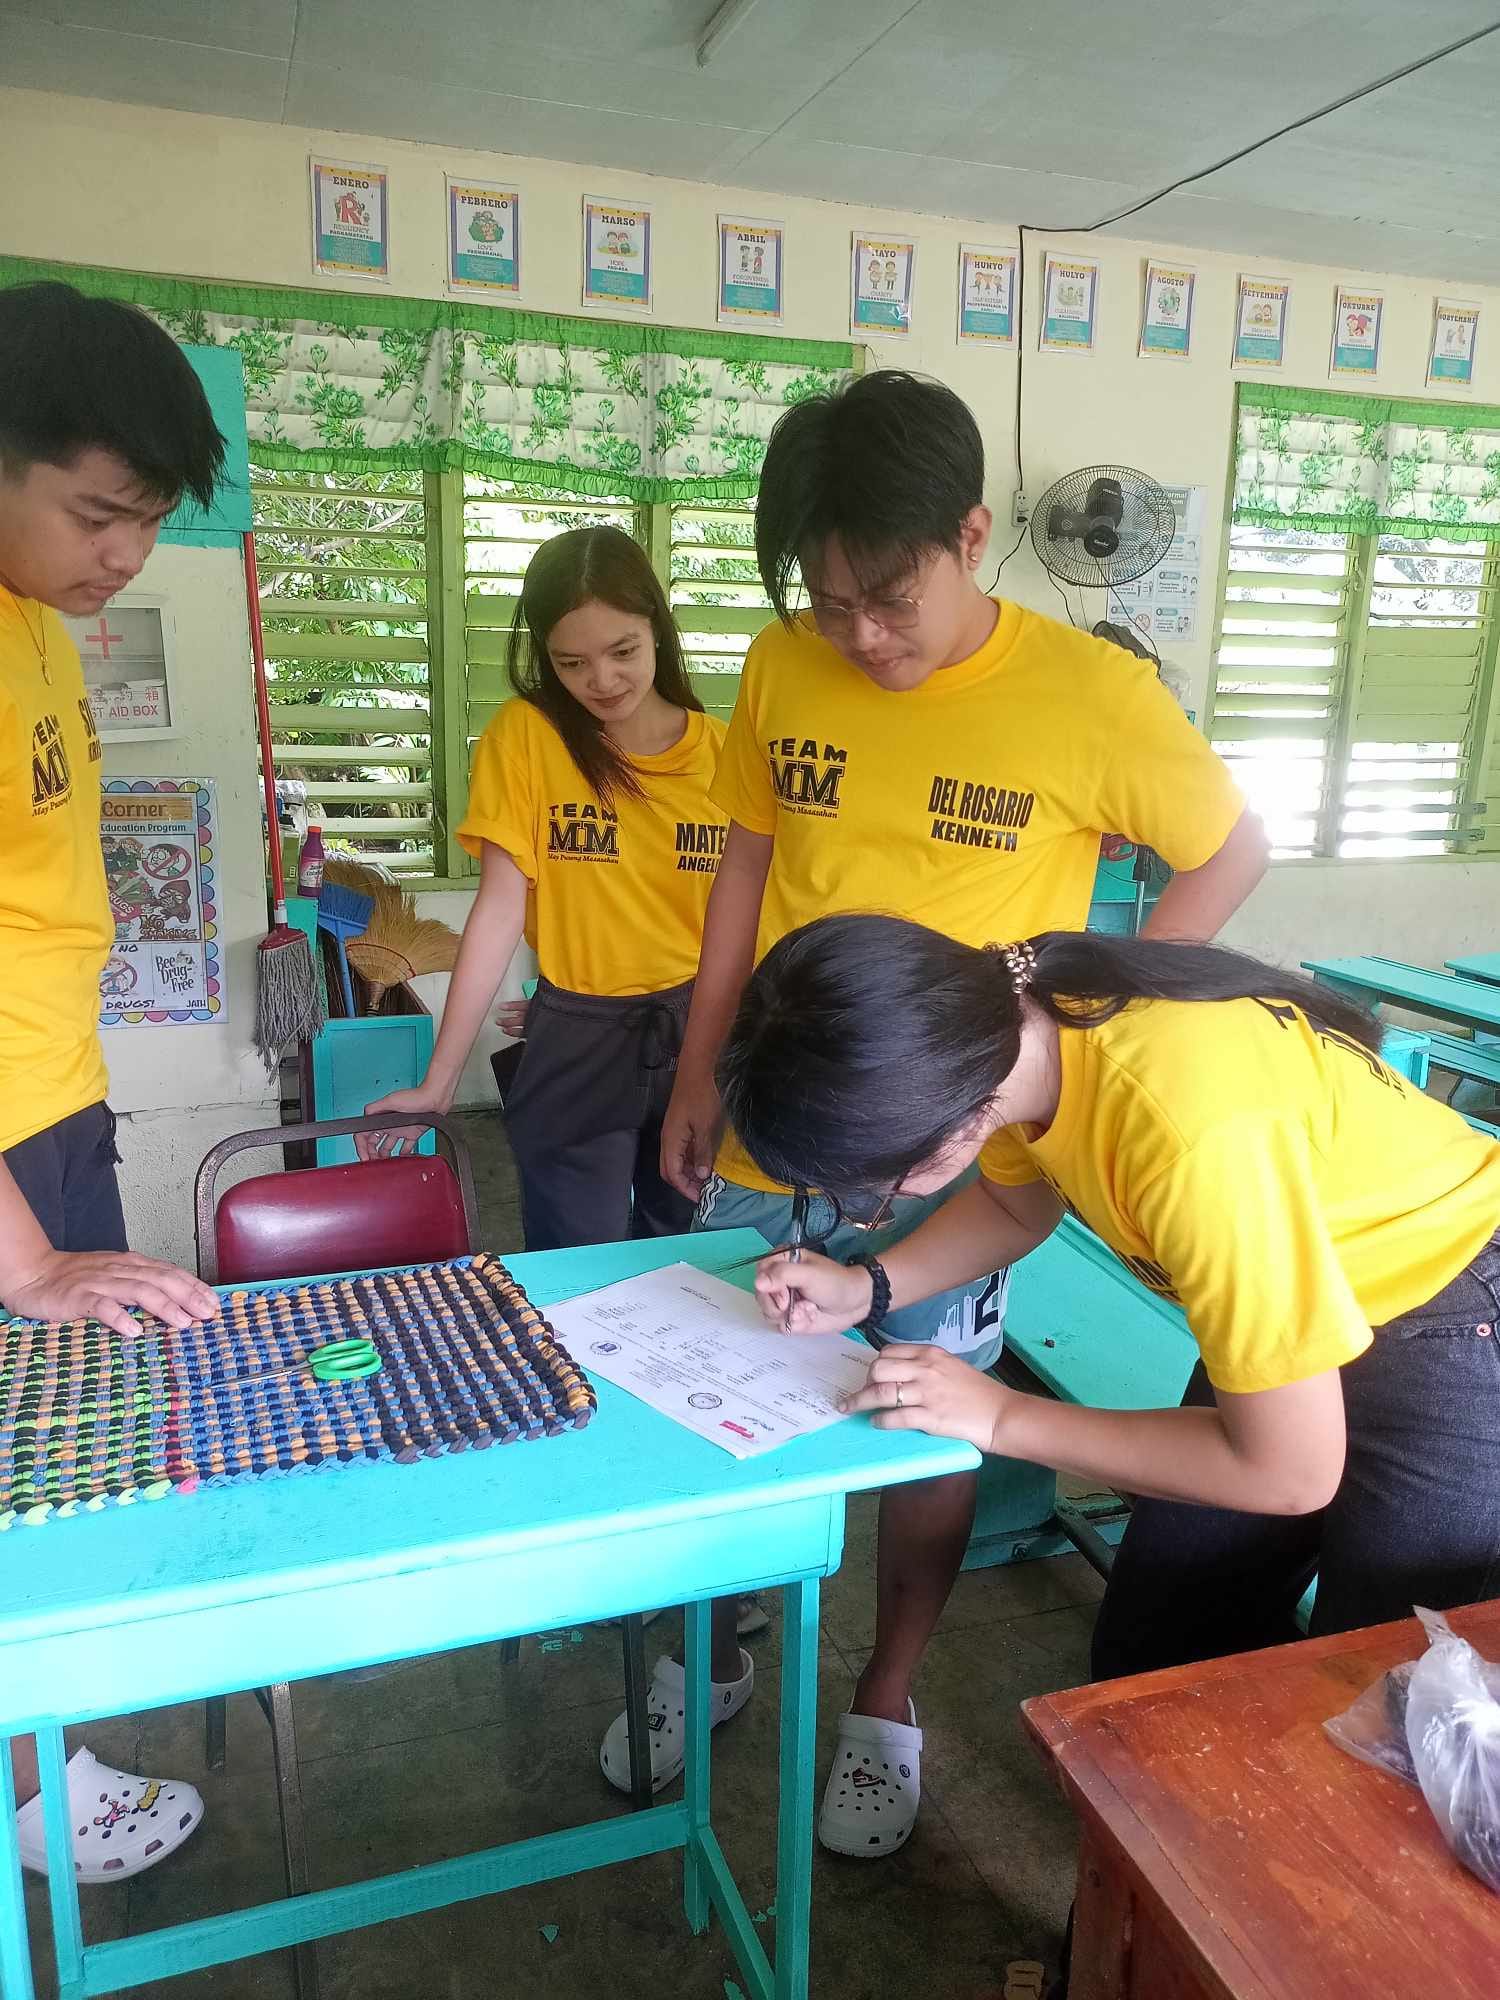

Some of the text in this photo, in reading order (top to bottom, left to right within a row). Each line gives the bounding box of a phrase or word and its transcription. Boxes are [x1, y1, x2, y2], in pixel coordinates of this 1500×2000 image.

[333, 176, 369, 189] ENERO
[461, 195, 508, 208] PEBRERO
[602, 215, 636, 226] MARSO
[737, 233, 766, 244] ABRIL
[974, 261, 1003, 271] HUNYO
[1060, 270, 1085, 280] HULYO
[1157, 277, 1184, 287] AGOSTO
[1342, 302, 1376, 311] OKTUBRE
[110, 706, 129, 718] AID
[133, 705, 159, 717] BOX
[768, 738, 848, 762] TEAM
[769, 758, 845, 809] MM
[101, 800, 167, 817] Corner
[928, 776, 1035, 829] DEL ROSARIO
[549, 803, 618, 823] TEAM
[100, 823, 186, 833] Education Program
[930, 819, 1018, 852] KENNETH
[548, 819, 620, 857] MM
[675, 823, 727, 854] MATE
[677, 855, 719, 873] ANGEL
[108, 891, 135, 914] RUGS
[118, 944, 139, 953] NO
[155, 954, 176, 972] Bee
[160, 965, 193, 985] Drug-
[171, 978, 195, 993] Free
[105, 1000, 155, 1010] DRUGS!
